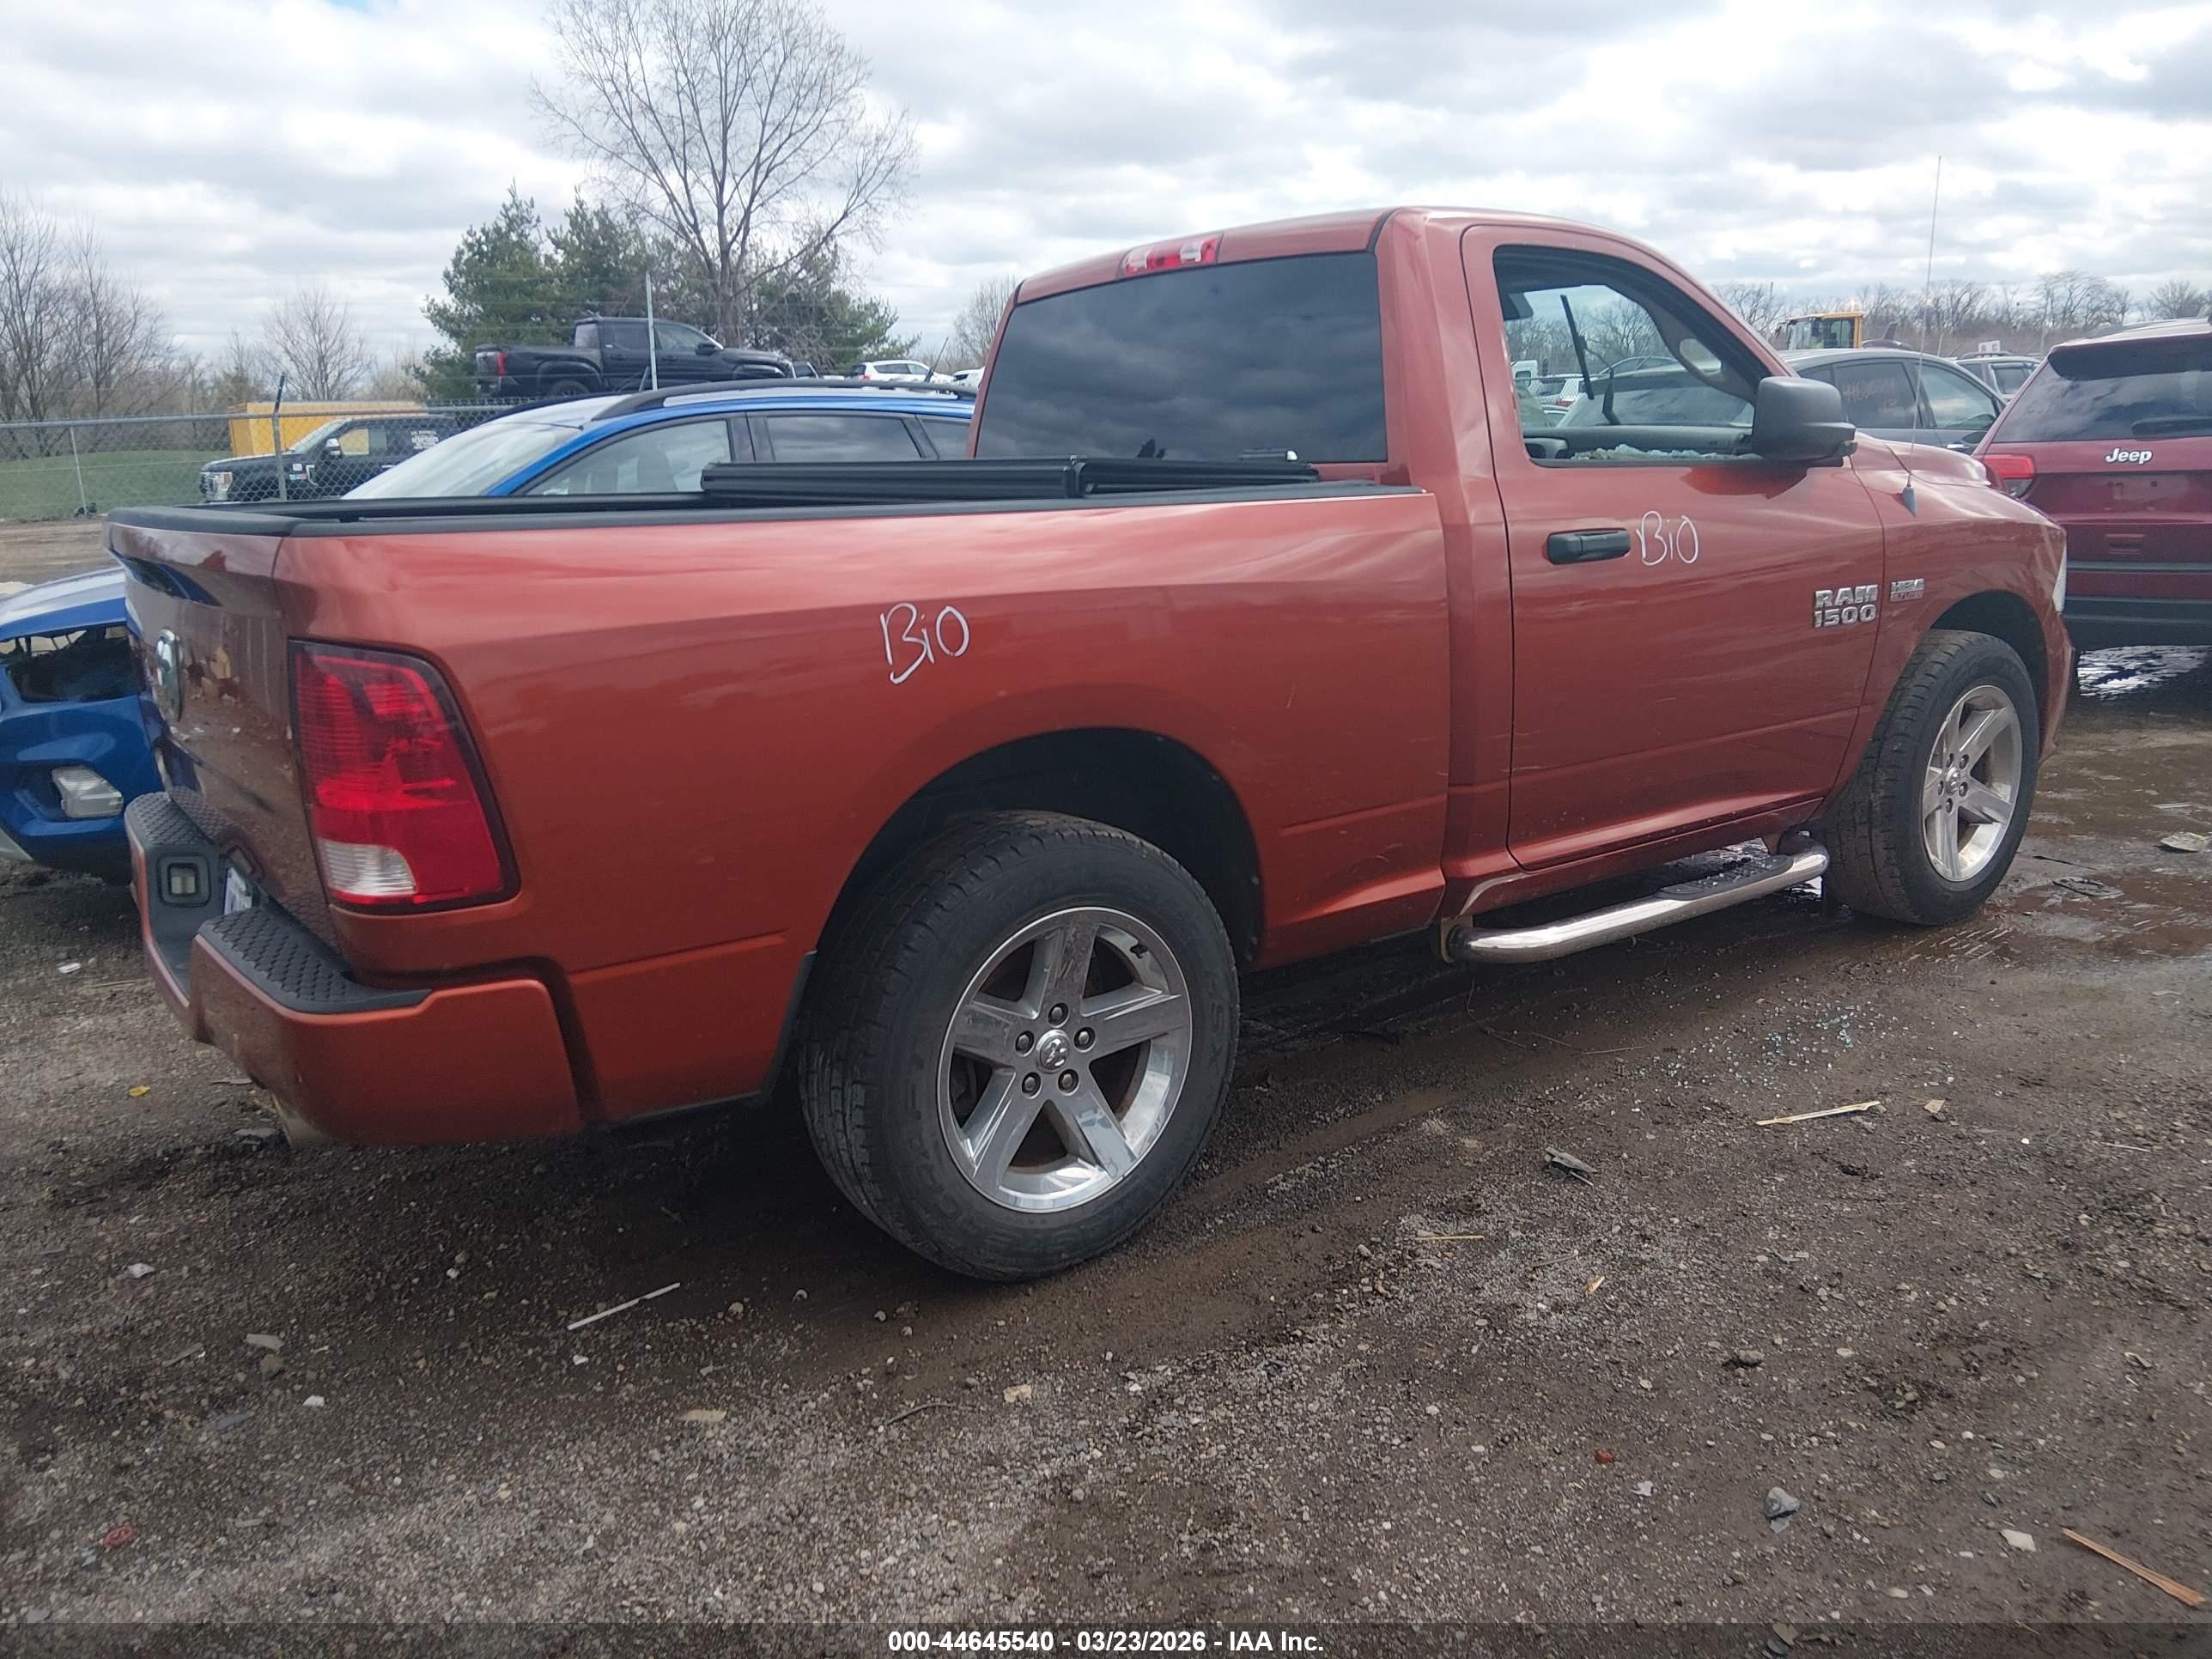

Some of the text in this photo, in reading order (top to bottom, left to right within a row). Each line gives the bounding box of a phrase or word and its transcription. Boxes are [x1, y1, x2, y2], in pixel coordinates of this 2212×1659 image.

[2105, 447, 2153, 465] Jeep
[1814, 584, 1879, 609] RAM
[1814, 604, 1877, 629] 1500
